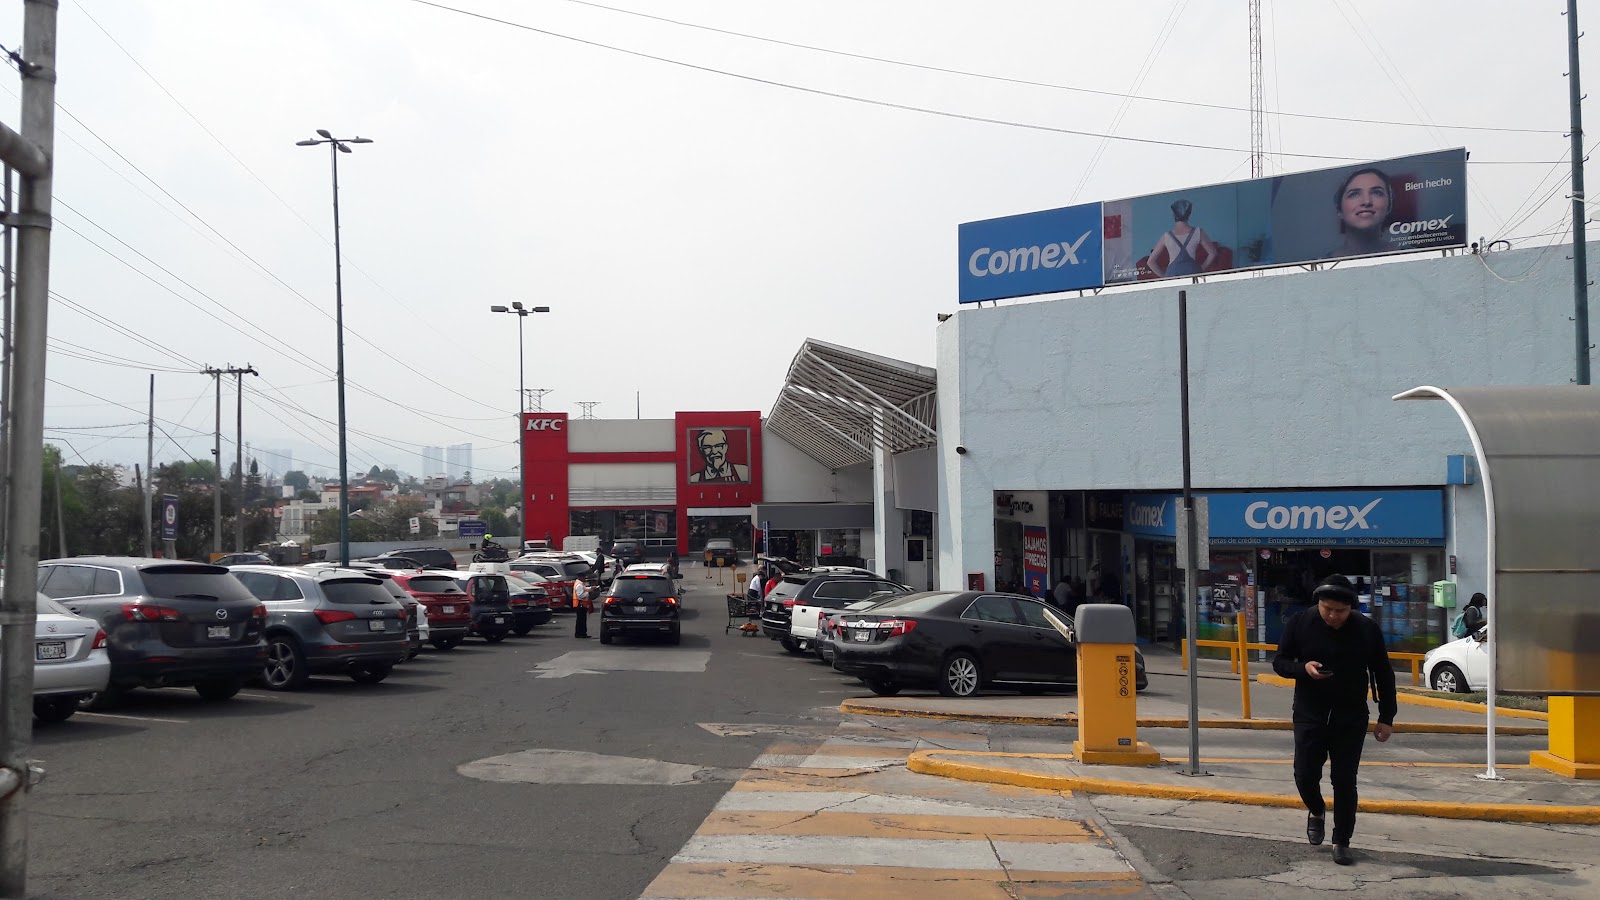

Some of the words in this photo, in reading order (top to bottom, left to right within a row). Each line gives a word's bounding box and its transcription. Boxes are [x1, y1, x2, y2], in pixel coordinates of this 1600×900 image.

[1405, 182, 1423, 191] Bien
[1426, 178, 1452, 188] hecho
[1389, 214, 1454, 234] Comex
[968, 230, 1093, 277] Comex
[526, 419, 563, 431] KFC
[1099, 502, 1122, 520] FALAFE
[1131, 500, 1167, 528] Comex
[1245, 497, 1383, 530] Comex
[1268, 537, 1298, 546] Entregas
[1304, 537, 1338, 545] domicilio
